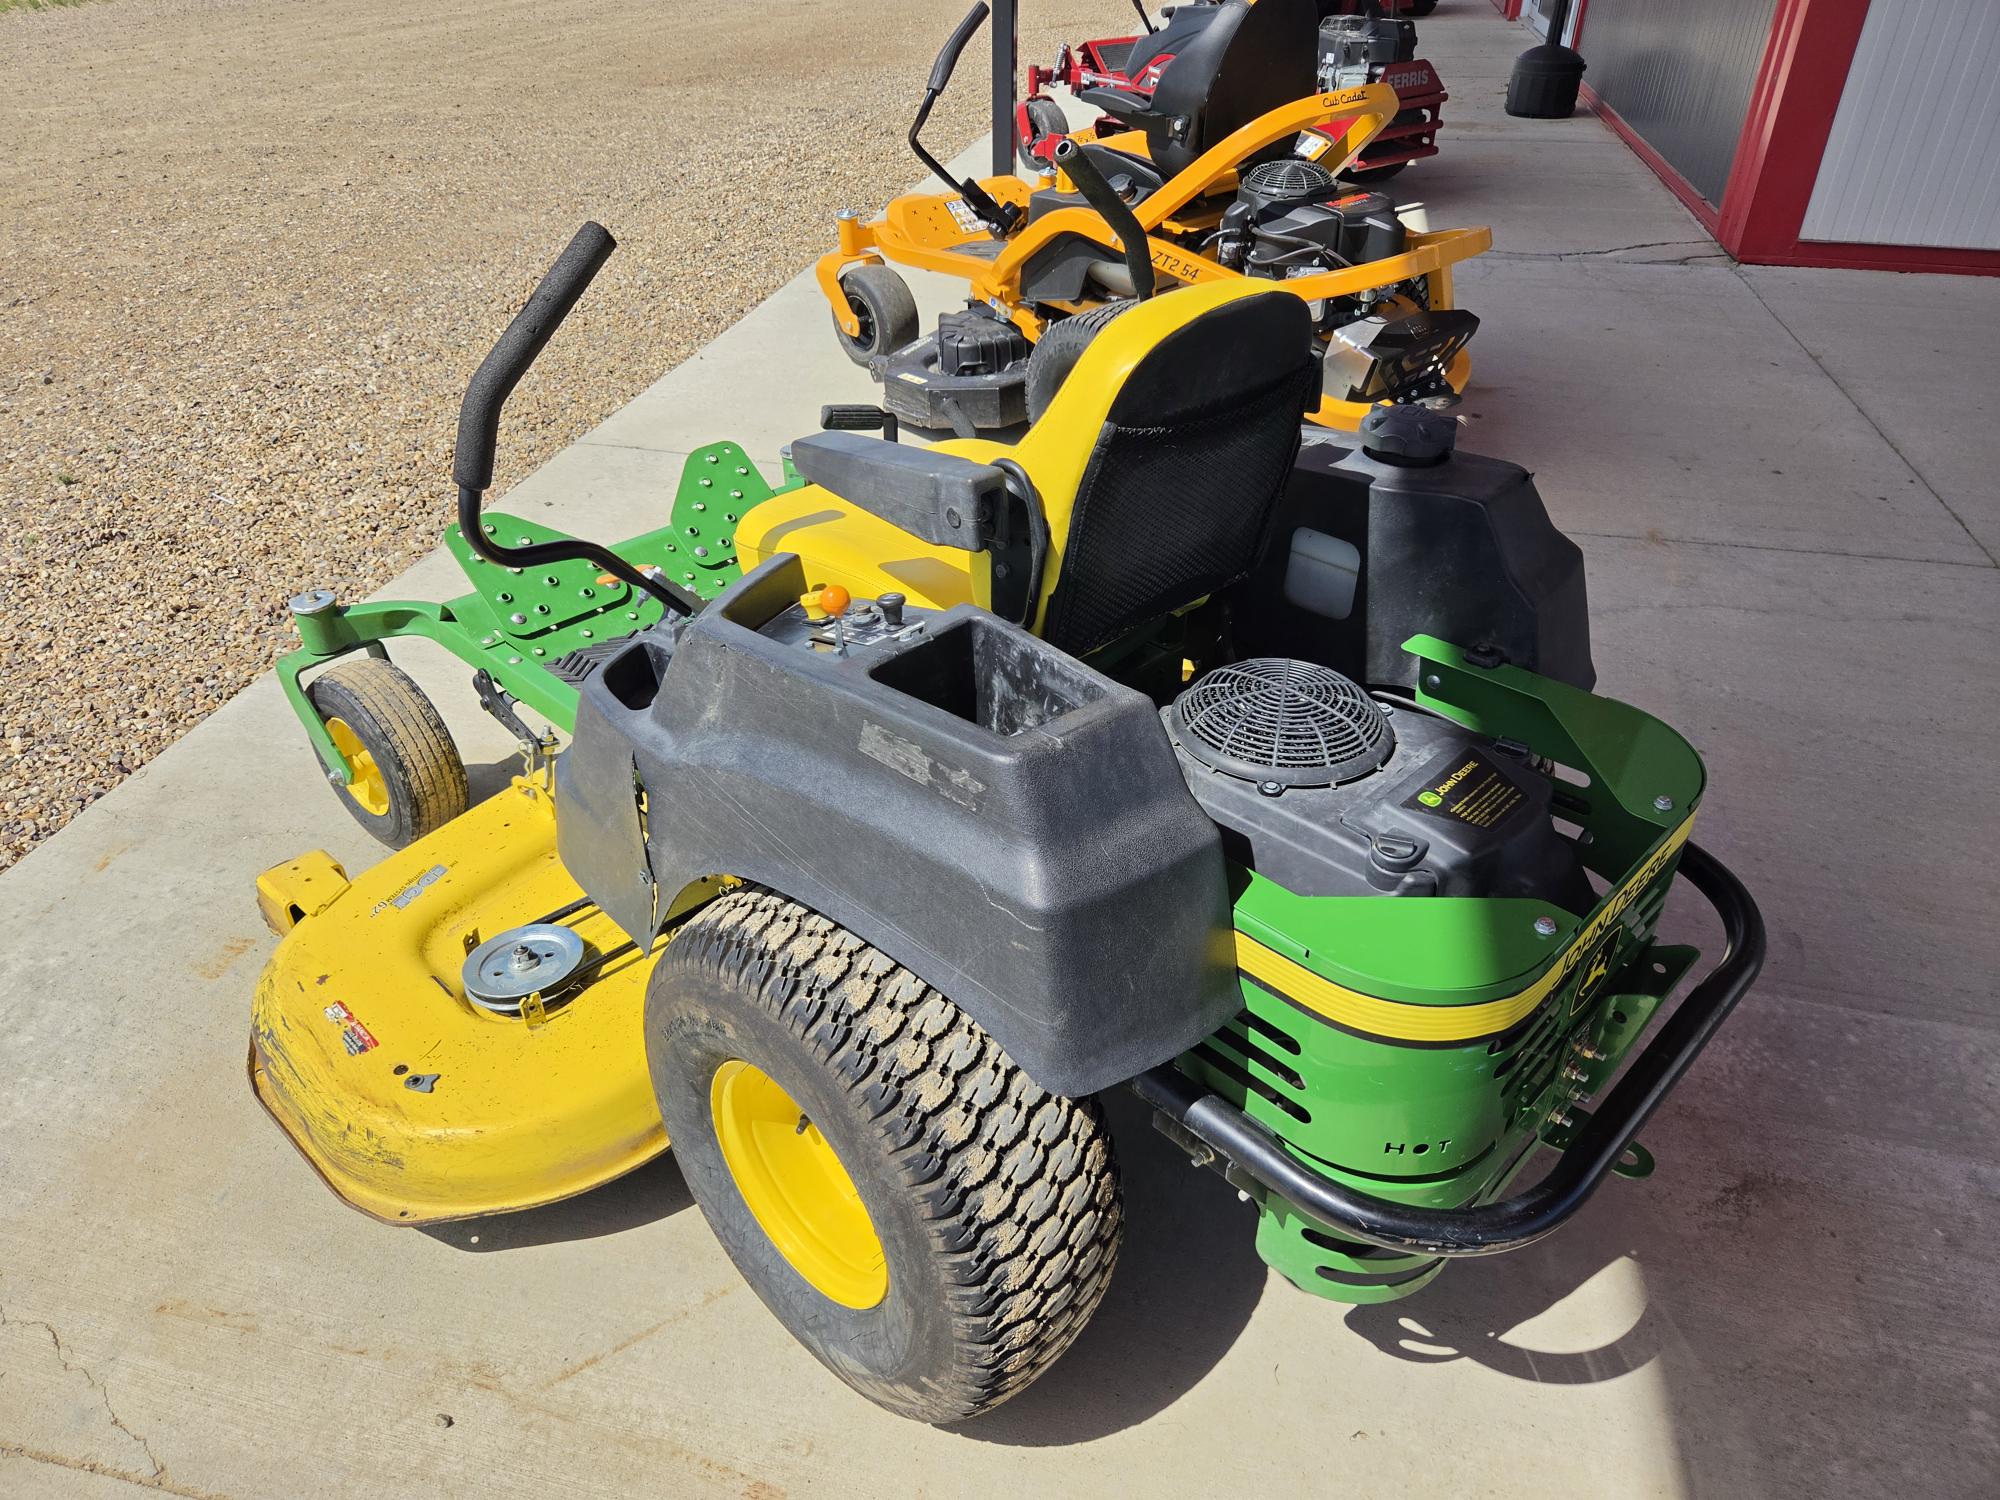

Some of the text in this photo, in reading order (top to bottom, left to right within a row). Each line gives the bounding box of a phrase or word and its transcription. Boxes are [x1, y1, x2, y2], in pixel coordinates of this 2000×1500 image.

[1387, 69, 1429, 89] FERRIS
[1322, 90, 1368, 107] Cub Cadet
[1151, 250, 1200, 281] ZT2 54
[1434, 760, 1479, 796] JOHN DEERE
[390, 863, 449, 910] EDGE
[1551, 843, 1672, 990] JOHN DEERE
[1383, 1138, 1453, 1156] HOT
